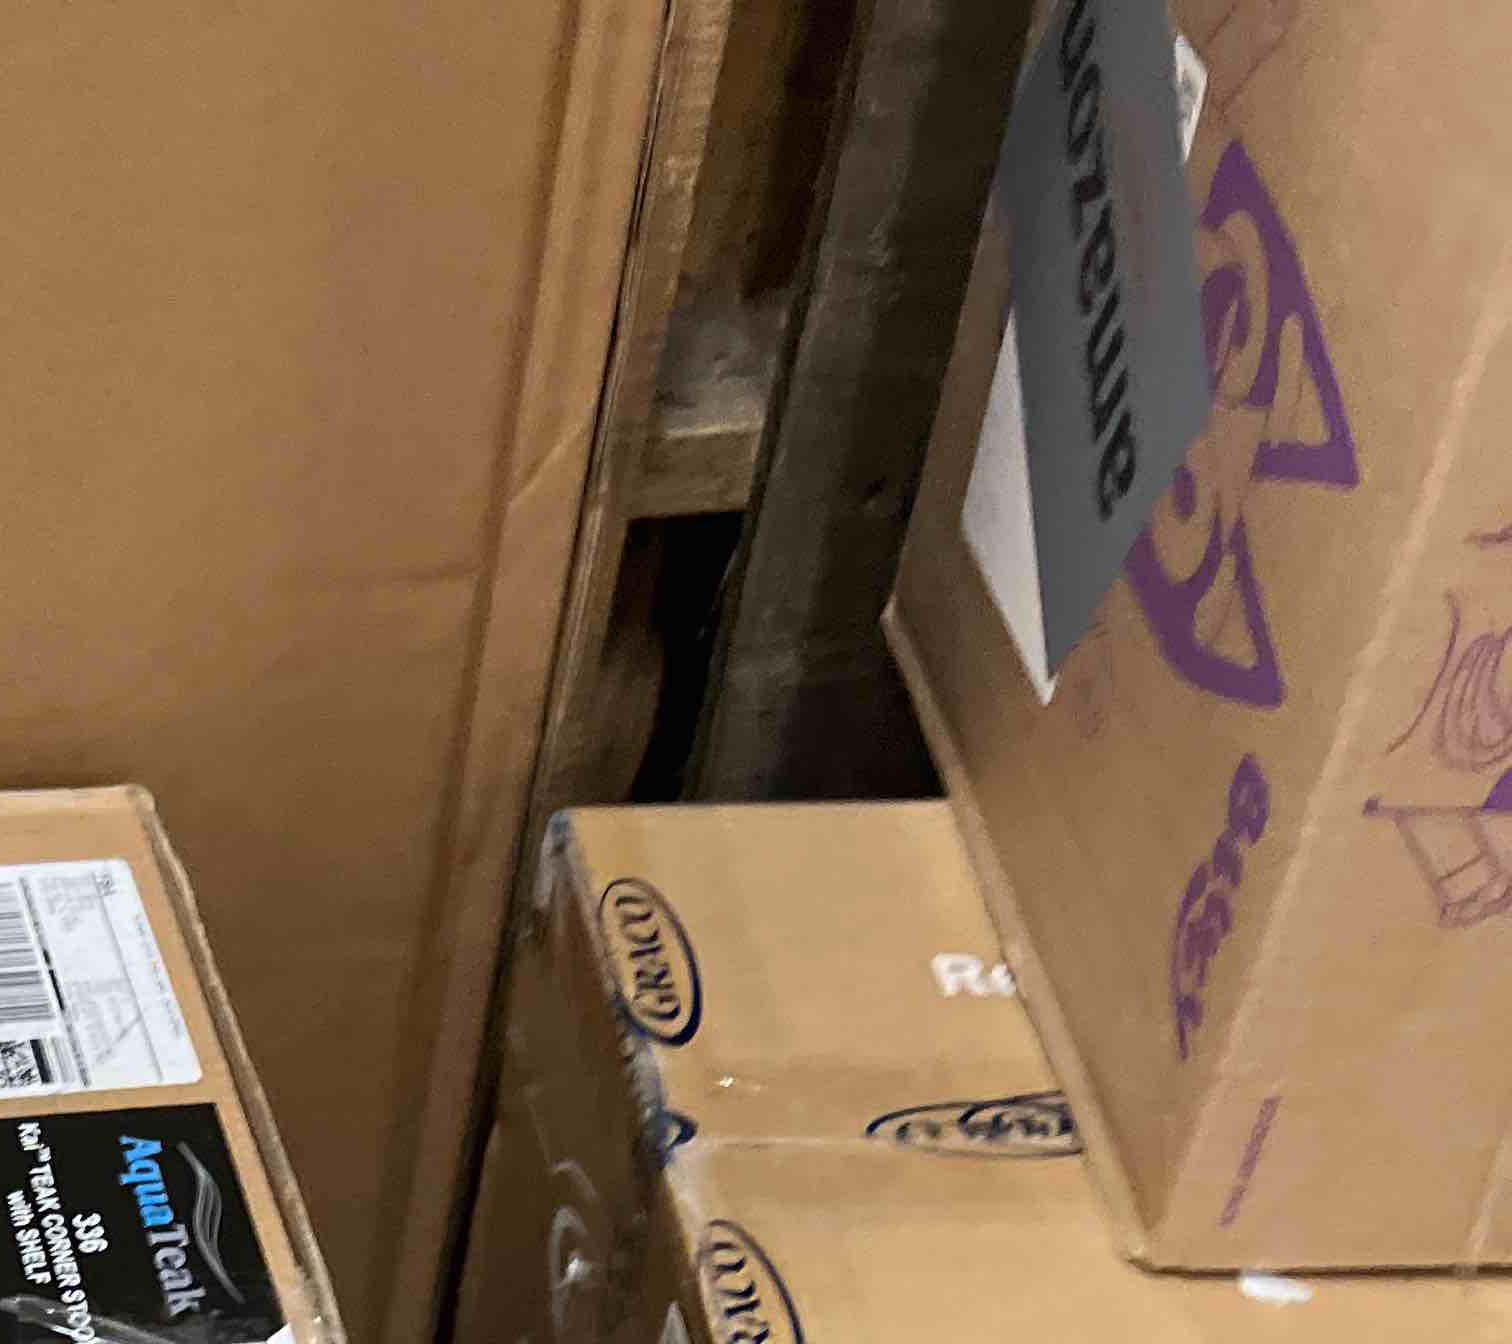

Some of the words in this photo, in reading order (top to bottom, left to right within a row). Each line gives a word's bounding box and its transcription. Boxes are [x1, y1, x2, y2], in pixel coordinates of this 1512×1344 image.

[5, 1189, 35, 1229] with
[29, 1162, 62, 1213] TEAK
[40, 1213, 82, 1289] CORNER
[71, 1212, 109, 1254] 336
[118, 1134, 208, 1318] AquaTeak
[15, 1228, 53, 1285] SHELF
